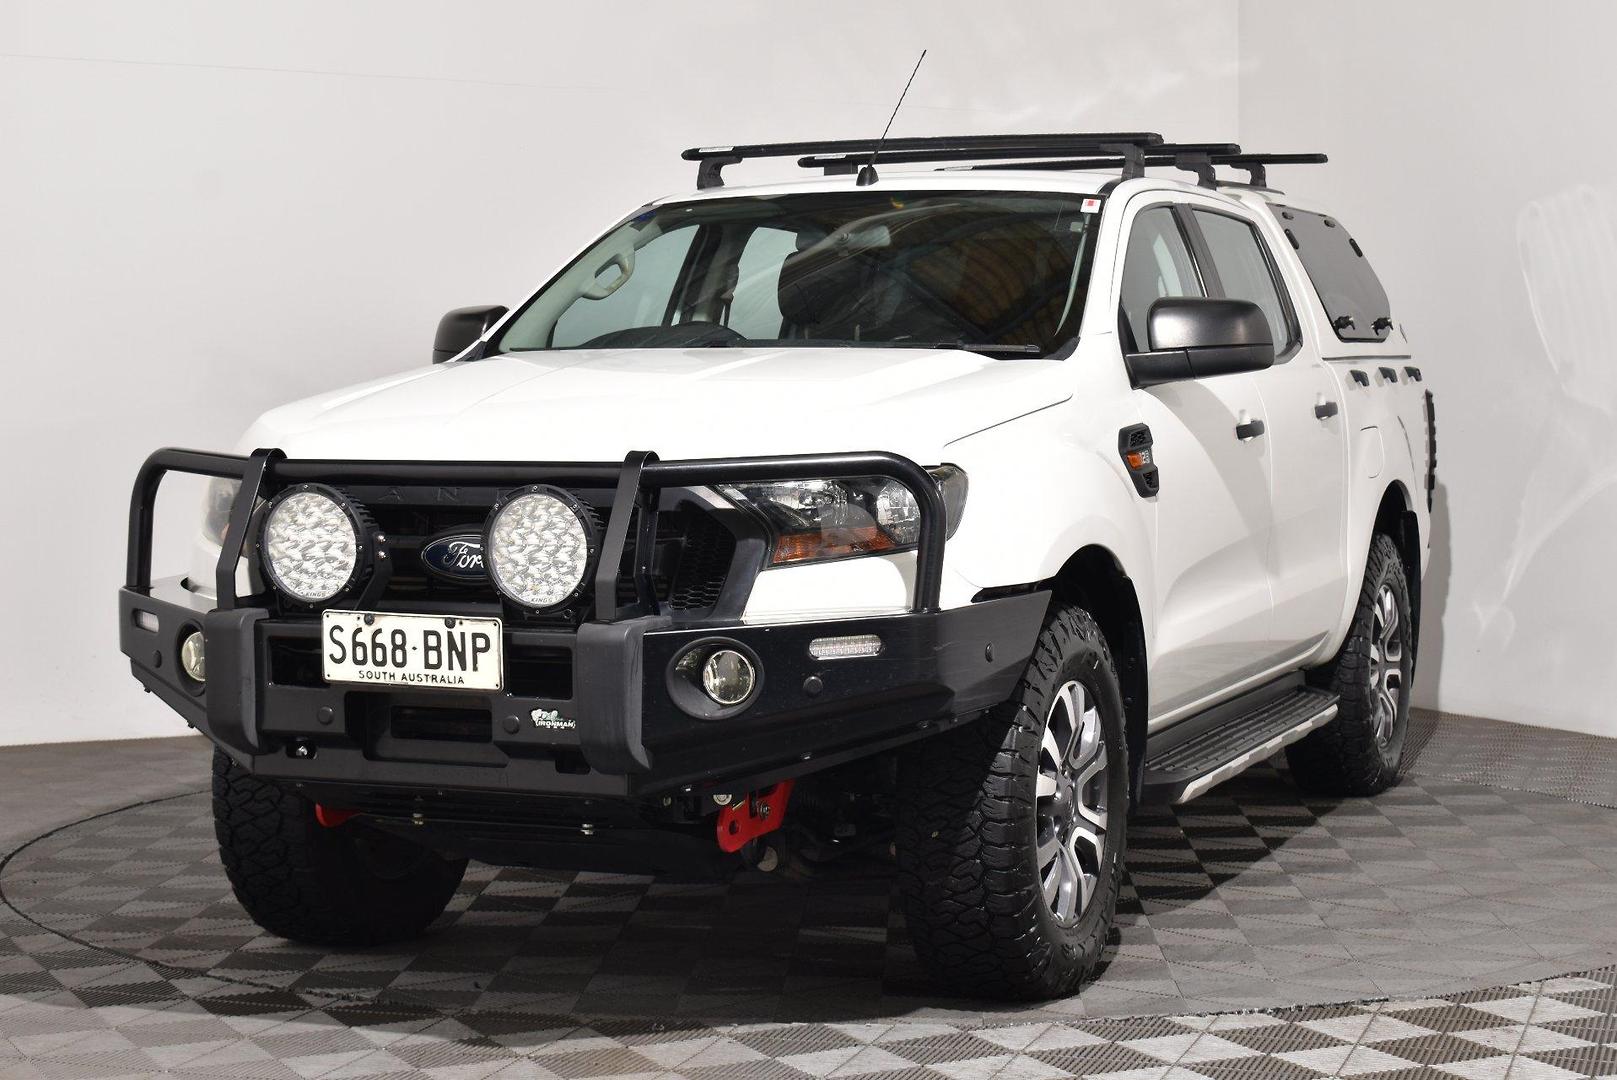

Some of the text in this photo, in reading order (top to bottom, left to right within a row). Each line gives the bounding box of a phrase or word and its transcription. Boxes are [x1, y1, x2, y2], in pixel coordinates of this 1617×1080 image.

[441, 541, 485, 569] For
[358, 670, 465, 685] SOUTH AUSTRALIA
